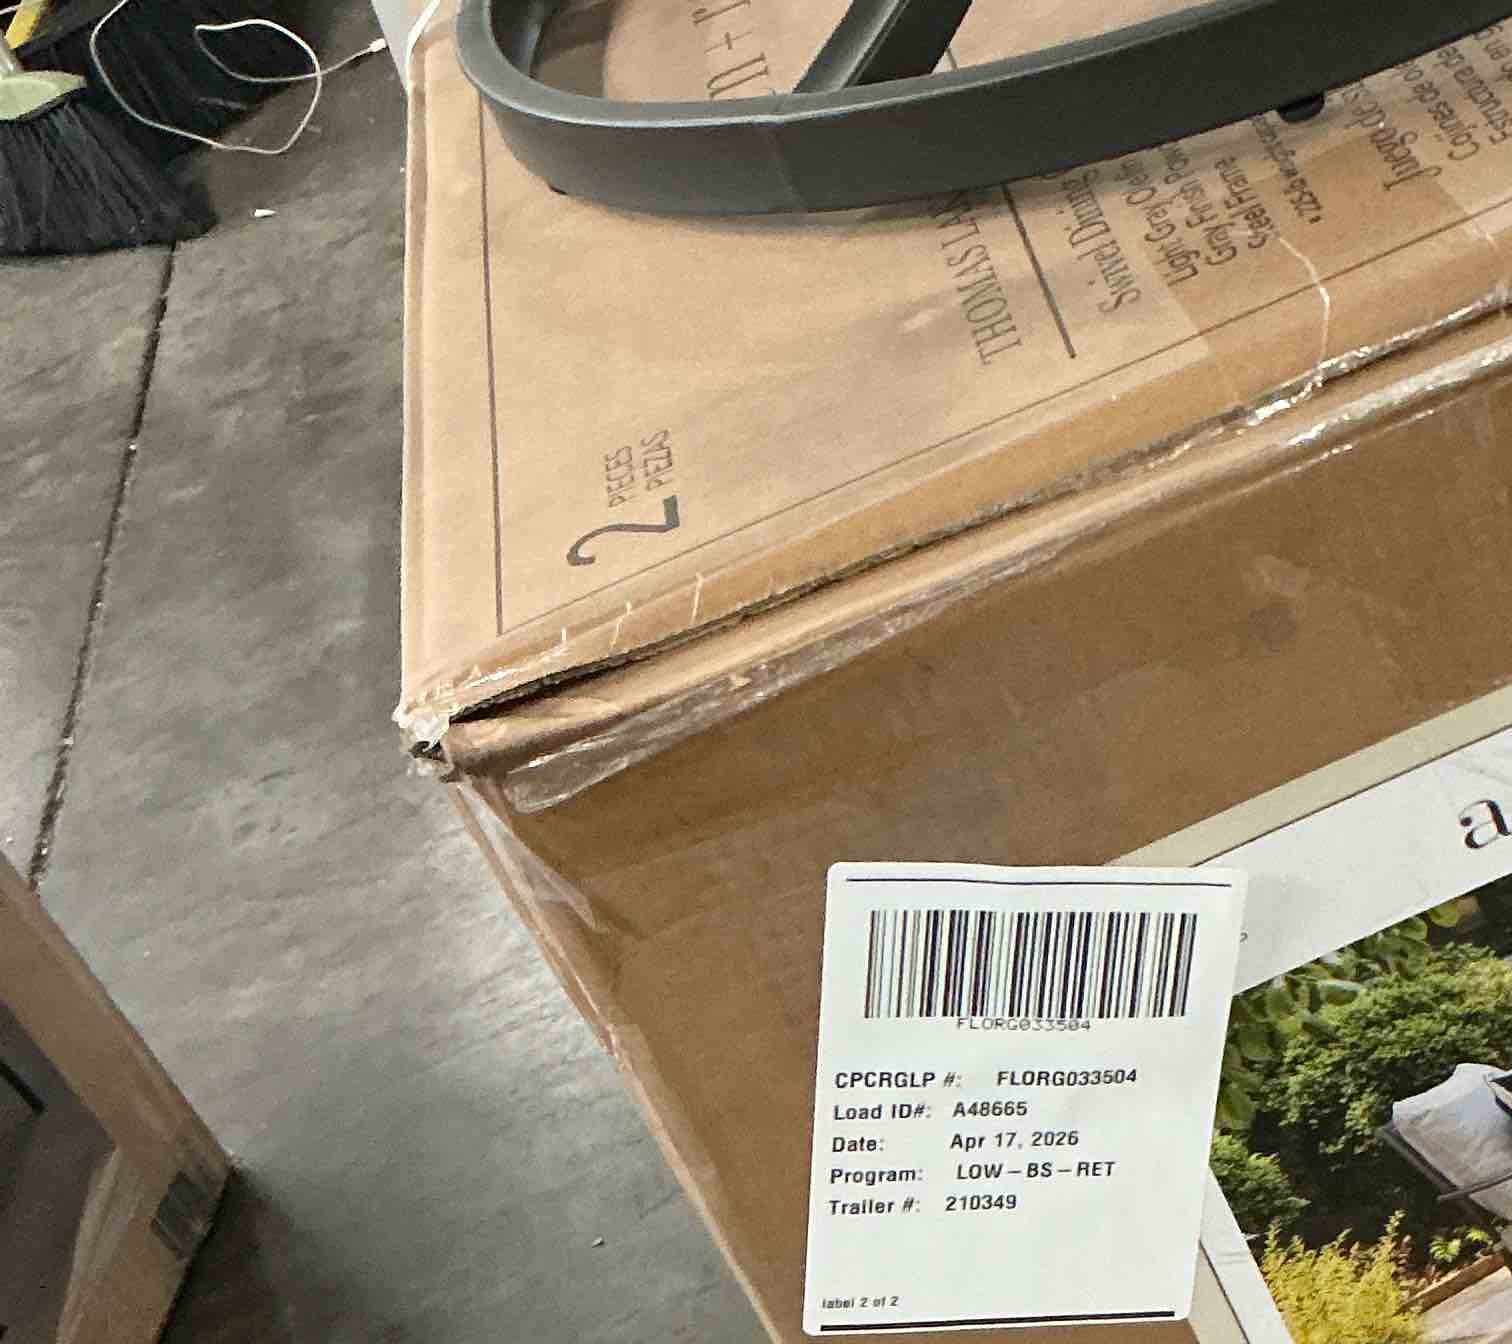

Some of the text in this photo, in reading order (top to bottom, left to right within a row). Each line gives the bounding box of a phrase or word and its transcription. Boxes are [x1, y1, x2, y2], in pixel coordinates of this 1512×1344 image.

[1363, 115, 1443, 193] Juego
[1419, 92, 1488, 165] Cojines
[1149, 234, 1209, 290] Light
[1192, 218, 1246, 269] Gray
[1075, 237, 1144, 316] Swivel
[941, 243, 1028, 366] THOMAS
[604, 446, 635, 508] PIECES
[566, 494, 680, 566] 2
[955, 1017, 1092, 1032] FLORG033504
[834, 1068, 1138, 1089] CPCRGLP #: FLORG033504
[834, 1101, 1028, 1120] Load ID#: A48665
[832, 1136, 885, 1152] Date:
[949, 1133, 984, 1151] Apr
[1031, 1131, 1079, 1147] 2026
[830, 1167, 923, 1187] Program:
[828, 1195, 1017, 1215] Trailer #: 210349
[821, 1295, 899, 1309] label 2 of 2
